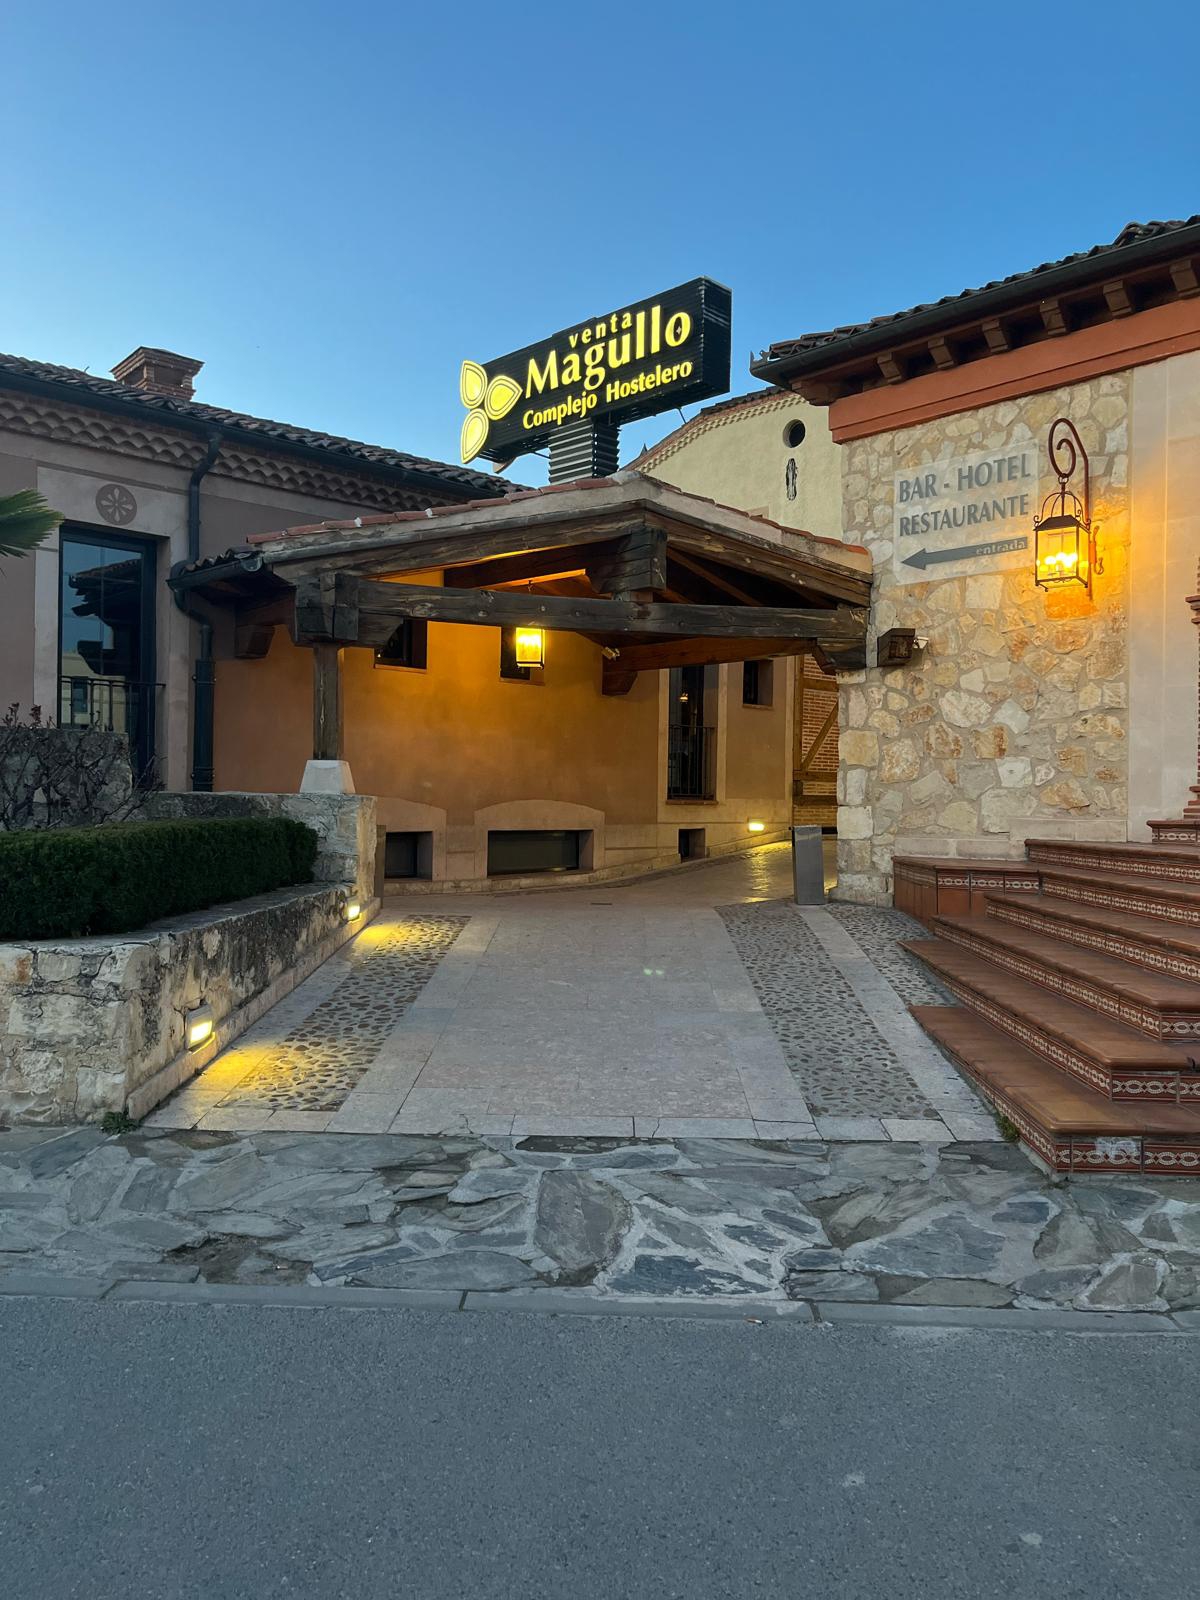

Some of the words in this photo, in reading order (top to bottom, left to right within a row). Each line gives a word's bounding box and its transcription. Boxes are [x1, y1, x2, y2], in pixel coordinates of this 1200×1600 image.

[525, 305, 691, 399] Magullo
[568, 312, 632, 348] venta
[522, 391, 598, 430] Complejo
[606, 361, 692, 403] Hostelero
[899, 473, 938, 503] BAR
[957, 453, 1031, 491] HOTEL
[899, 493, 1029, 537] RESTAURANTE
[975, 539, 1027, 556] entrada
